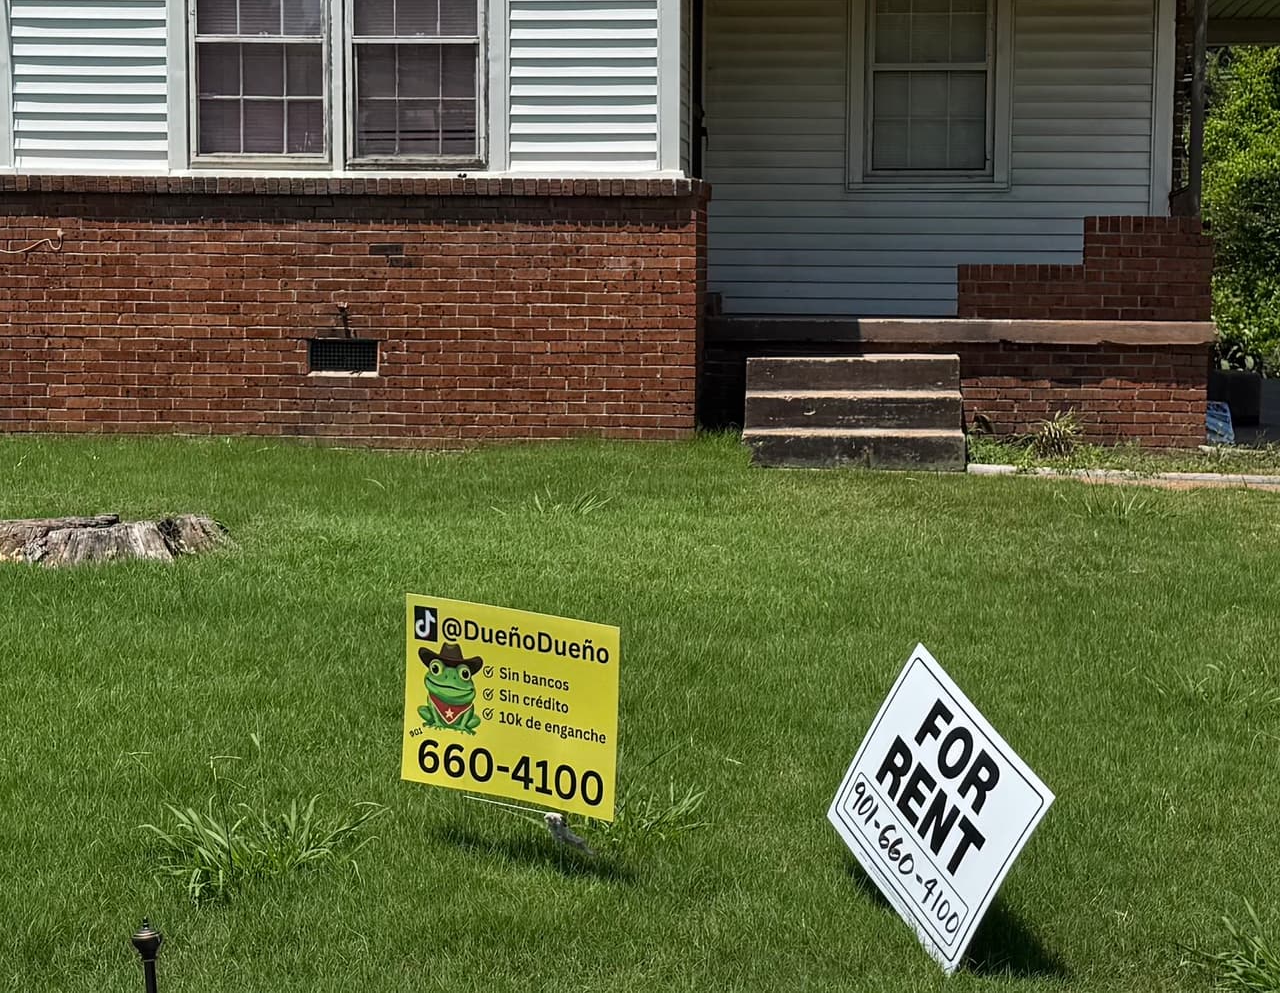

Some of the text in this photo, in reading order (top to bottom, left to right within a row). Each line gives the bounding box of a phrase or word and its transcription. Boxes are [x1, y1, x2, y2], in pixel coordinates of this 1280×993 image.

[442, 617, 610, 664] @DueñoDueño
[499, 667, 569, 691] Sin bancos
[499, 689, 569, 713] Sin crédito
[499, 711, 607, 744] 10k de enganche
[418, 739, 604, 806] 660-4100
[914, 698, 1000, 816] FOR
[875, 734, 986, 877] RENT
[852, 781, 960, 934] 901-660-4100
